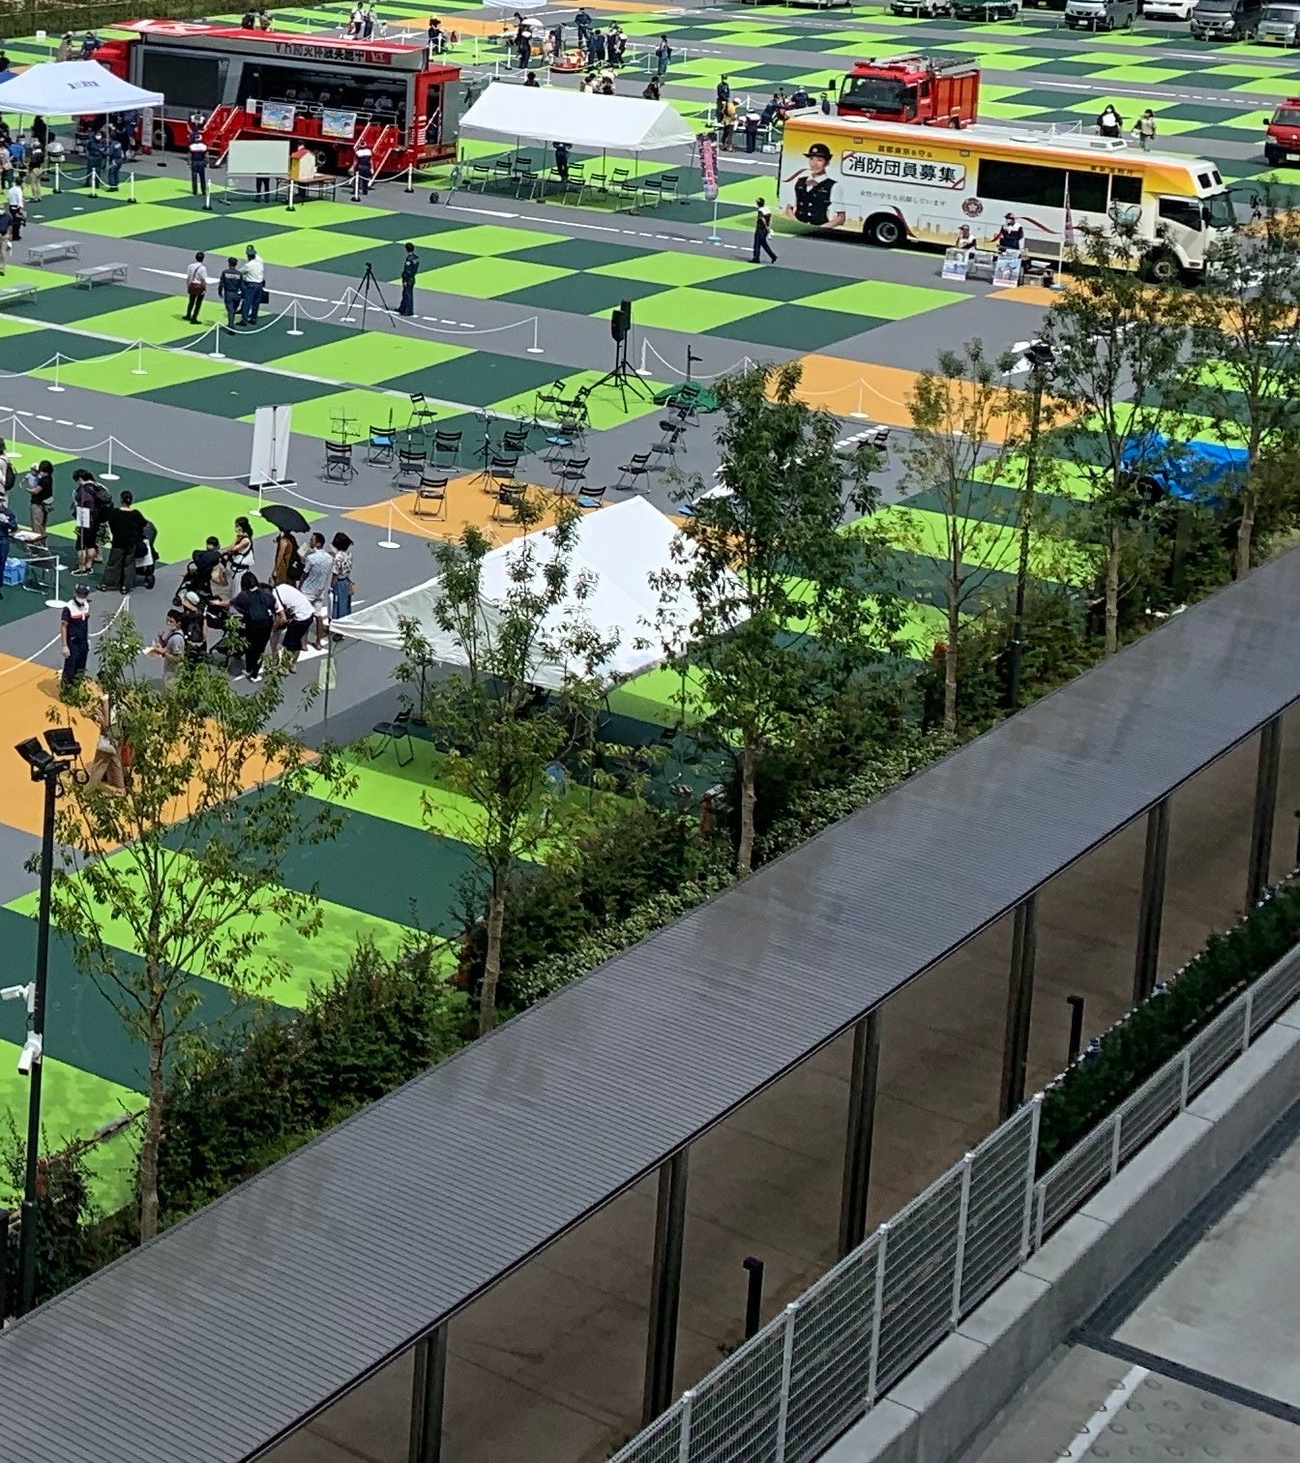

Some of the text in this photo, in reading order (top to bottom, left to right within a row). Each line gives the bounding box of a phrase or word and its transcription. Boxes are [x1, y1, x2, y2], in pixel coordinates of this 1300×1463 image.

[849, 156, 957, 184] 消防団員募集
